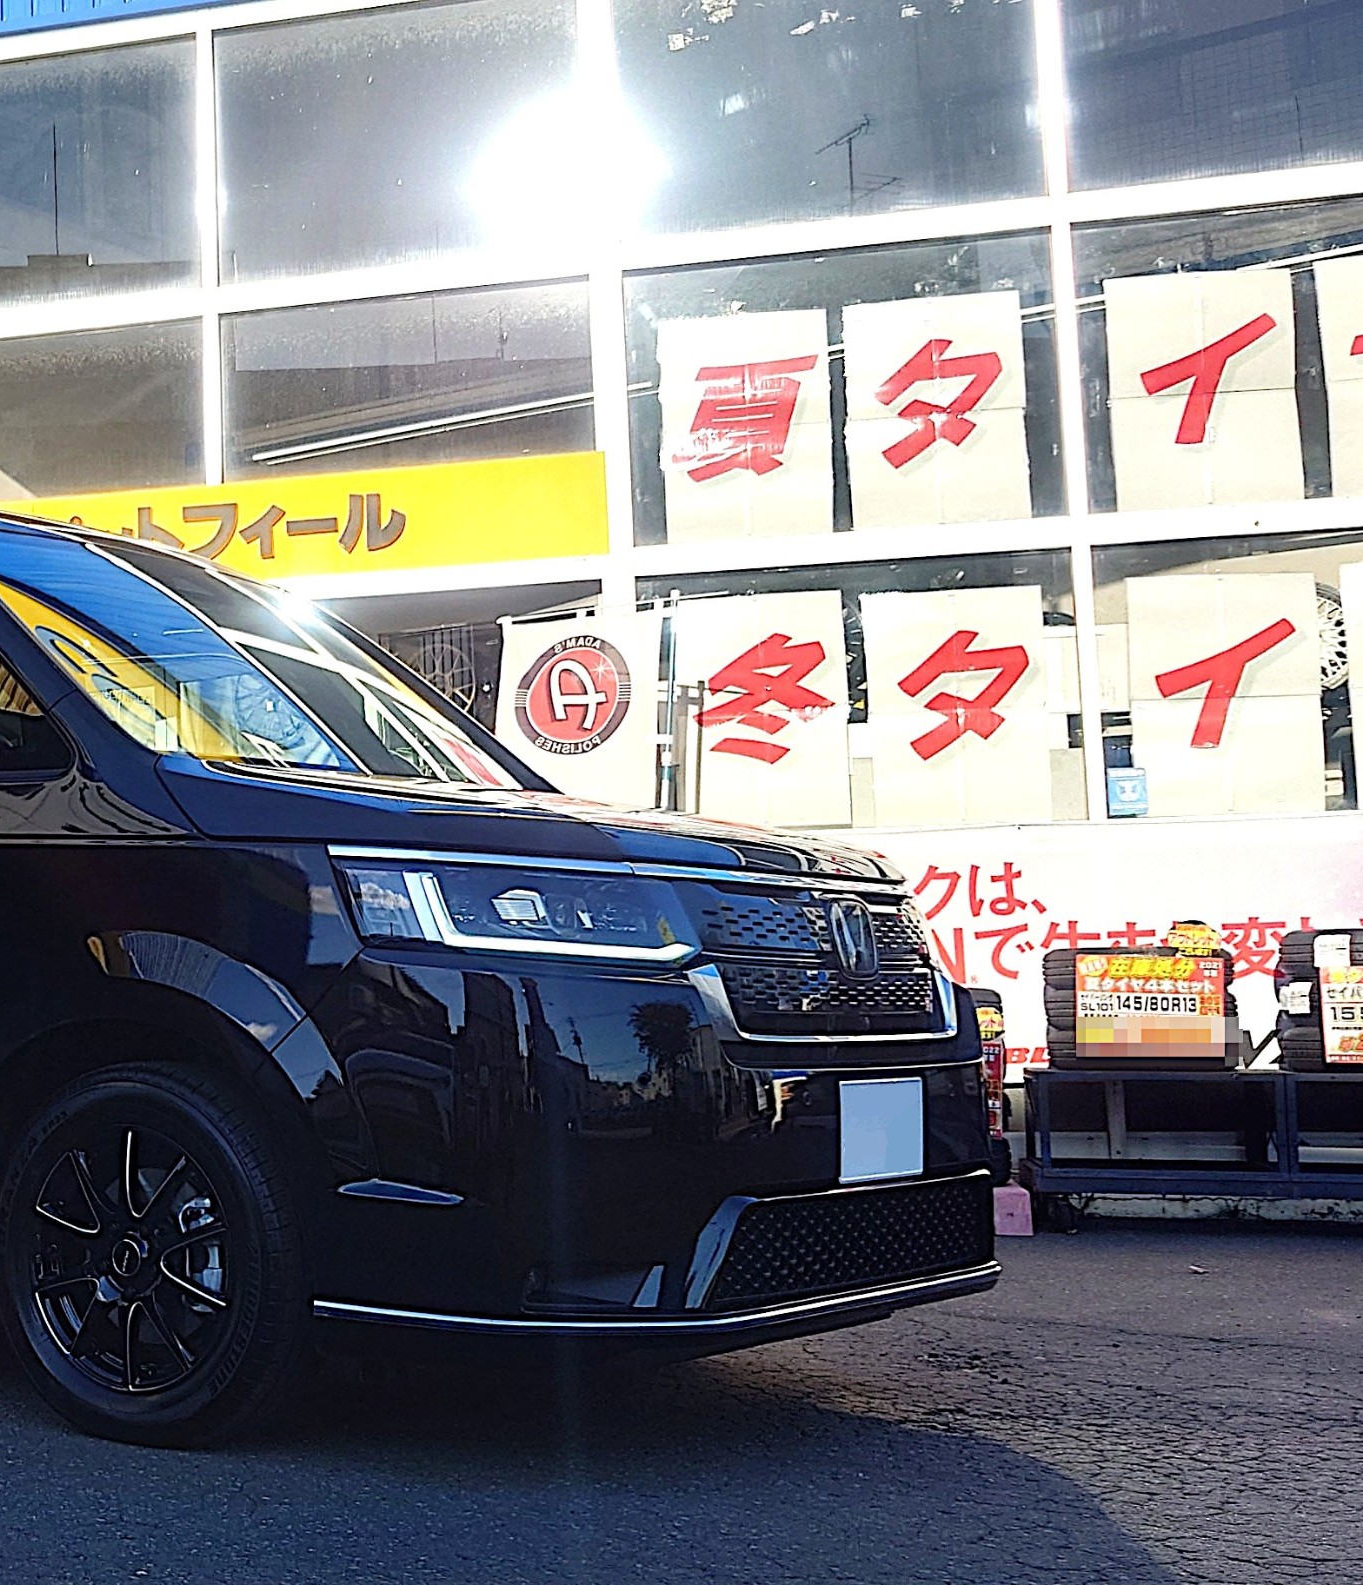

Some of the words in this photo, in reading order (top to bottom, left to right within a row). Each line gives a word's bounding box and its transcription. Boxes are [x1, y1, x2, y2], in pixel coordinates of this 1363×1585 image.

[672, 313, 1363, 482] 夏タイ
[70, 493, 406, 560] トフィール
[1116, 995, 1197, 1014] 145/80R13
[1330, 1006, 1363, 1022] 15
